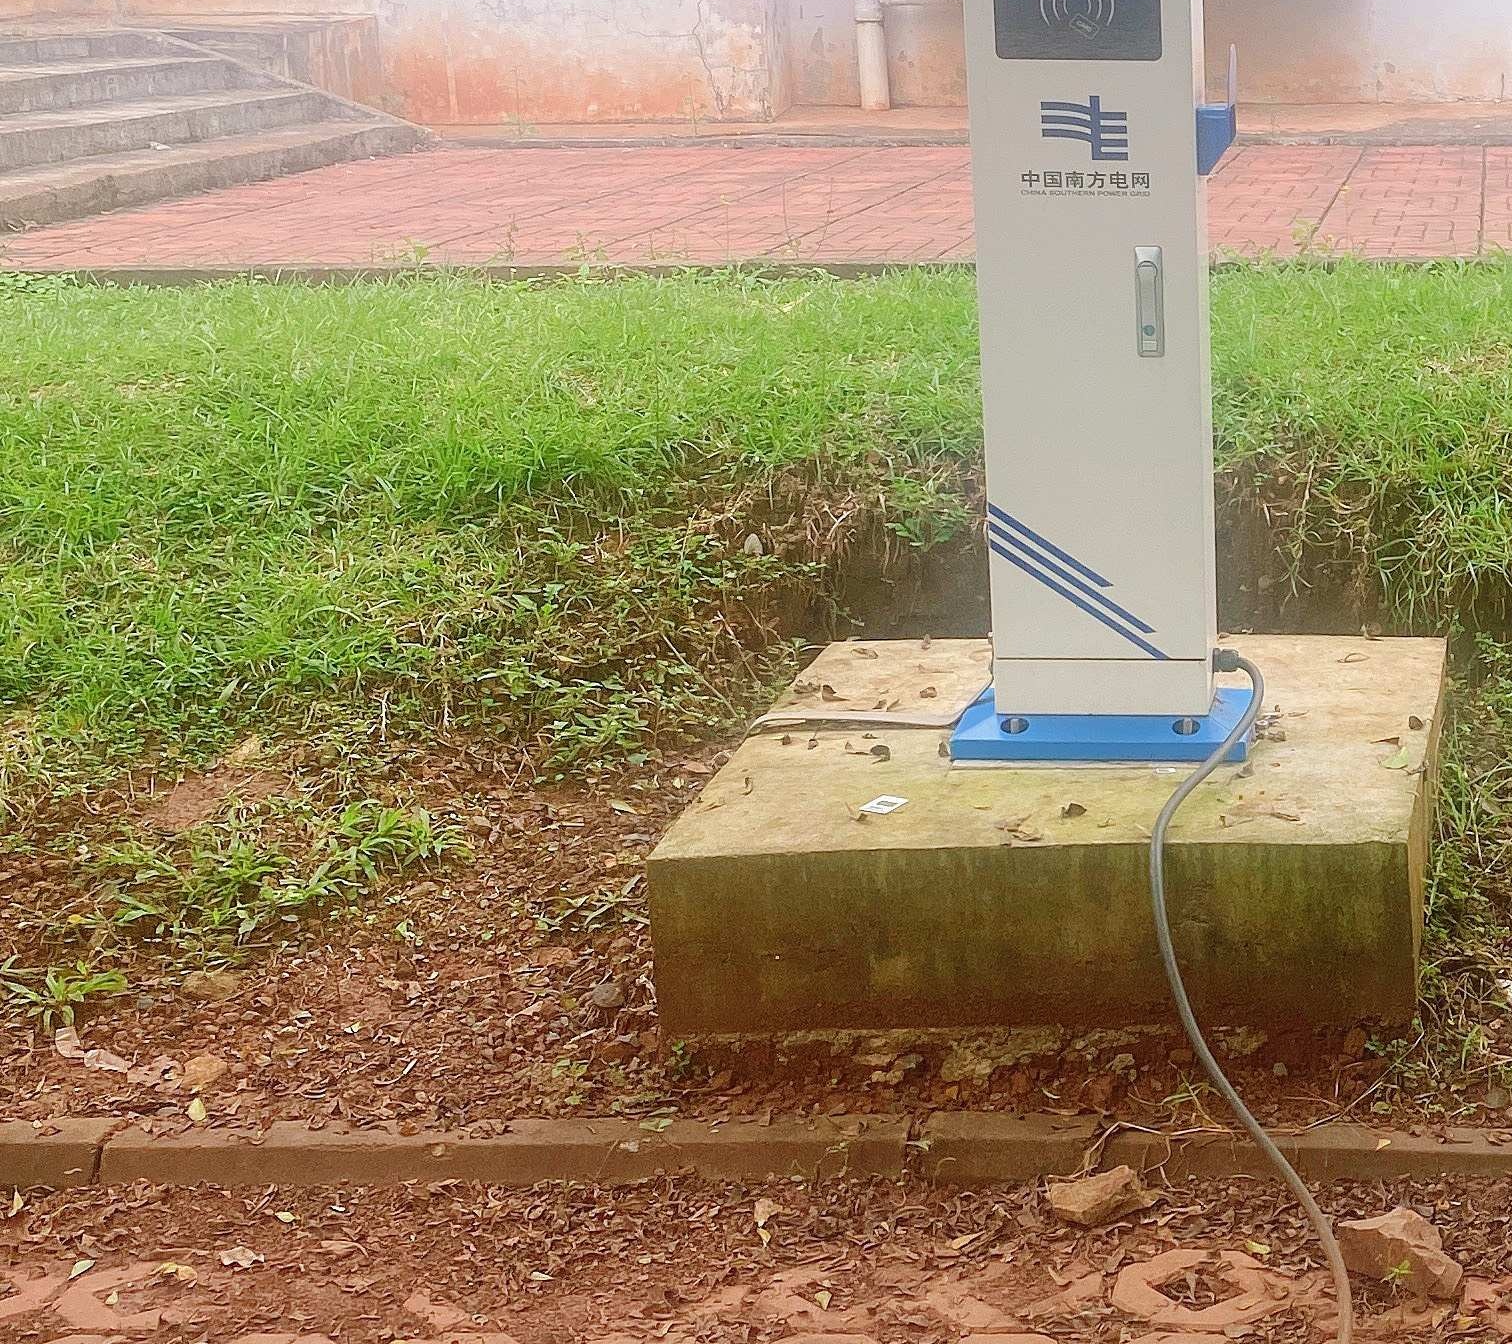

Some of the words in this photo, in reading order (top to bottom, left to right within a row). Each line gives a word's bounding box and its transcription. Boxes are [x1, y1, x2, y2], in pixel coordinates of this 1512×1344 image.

[1020, 170, 1151, 189] 中国南方电网
